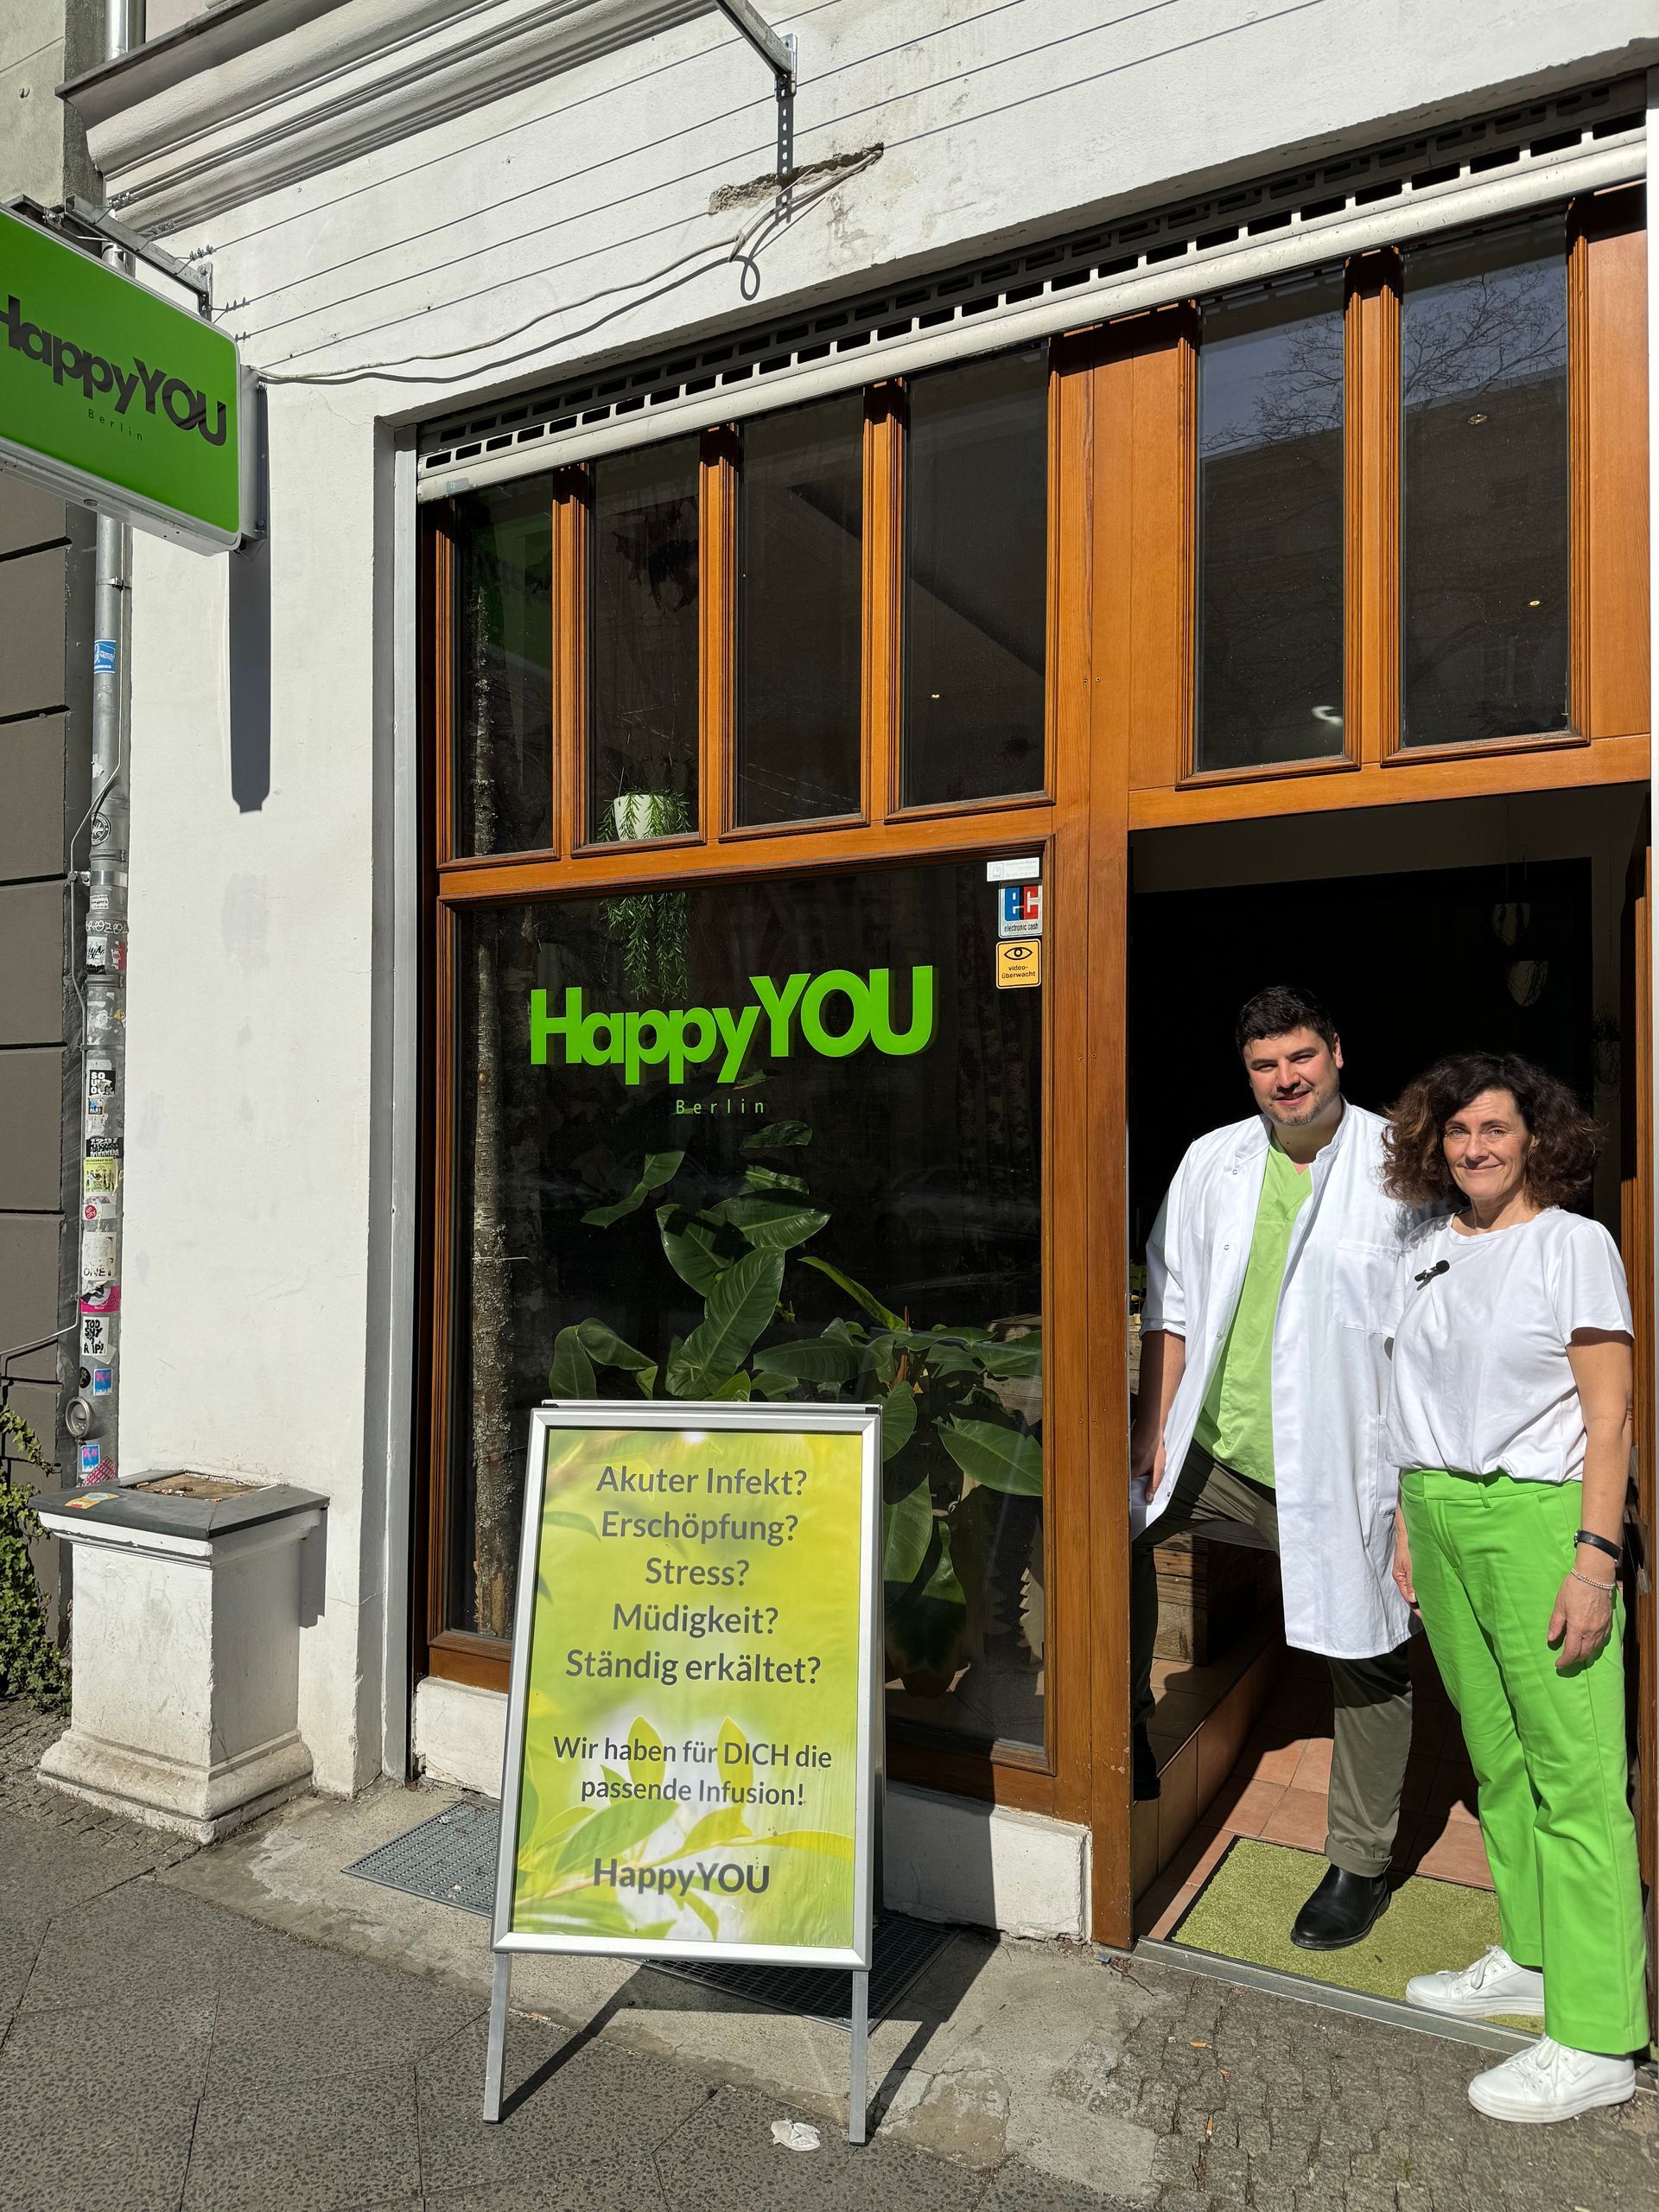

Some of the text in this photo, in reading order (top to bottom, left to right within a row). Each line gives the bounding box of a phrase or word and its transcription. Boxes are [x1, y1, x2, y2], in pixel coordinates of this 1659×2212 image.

[0, 295, 227, 446] HappyYOU
[88, 408, 143, 442] Berlin
[1004, 924, 1027, 932] electronic
[1001, 970, 1036, 979] überwacht
[531, 965, 933, 1084] HappyYOU
[676, 1099, 765, 1115] Berlin
[596, 1466, 807, 1496] Akuter Infekt?
[602, 1512, 798, 1547] Erschöpfung?
[645, 1558, 750, 1586] Stress?
[613, 1604, 779, 1637] Müdigkeit?
[566, 1649, 821, 1685] Ständig erkältet?
[554, 1737, 832, 1769] Wir haben für DICH die
[581, 1778, 804, 1806] passende Infusion!
[594, 1859, 770, 1896] HappyYOU
